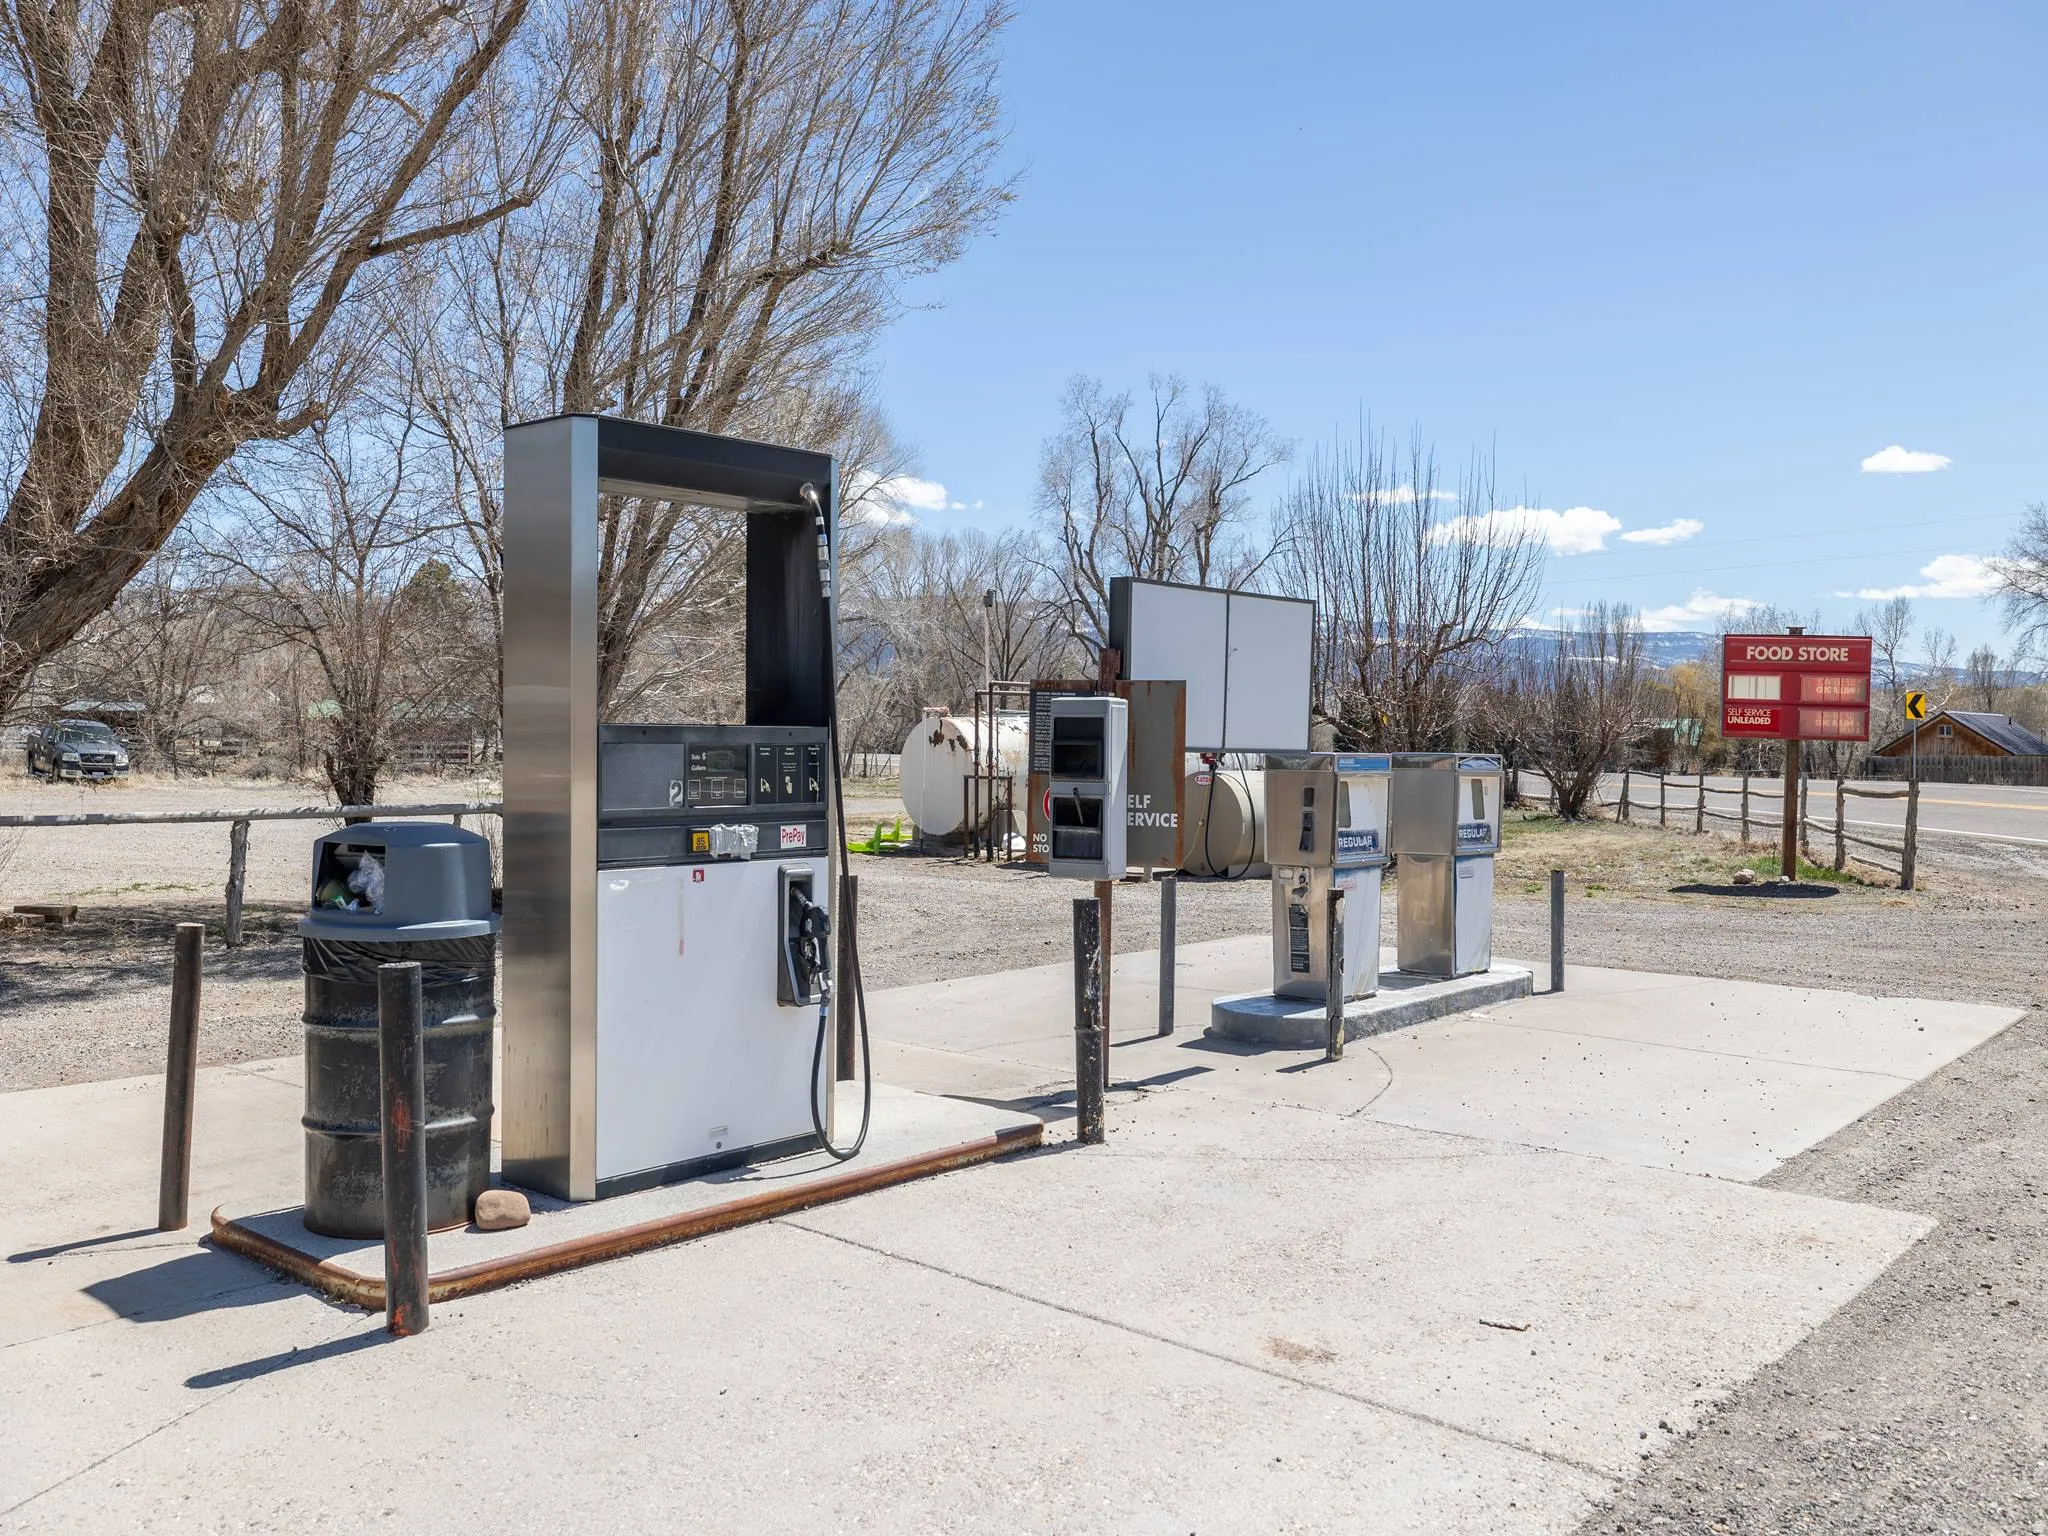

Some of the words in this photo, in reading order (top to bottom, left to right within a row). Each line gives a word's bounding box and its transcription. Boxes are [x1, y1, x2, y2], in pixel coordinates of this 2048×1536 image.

[1746, 646, 1793, 661] FOOD
[1798, 647, 1849, 662] STORE
[1727, 707, 1743, 716] SELF
[1744, 708, 1771, 717] SERVICE
[1727, 716, 1771, 725] UNLEADED
[671, 782, 682, 804] 2
[1127, 794, 1151, 809] ELF
[1127, 811, 1178, 828] ERVICE
[696, 836, 706, 846] 85
[781, 829, 805, 848] PrePay
[1032, 833, 1047, 842] NO
[1337, 835, 1373, 848] REGULAR
[1032, 844, 1050, 853] STO
